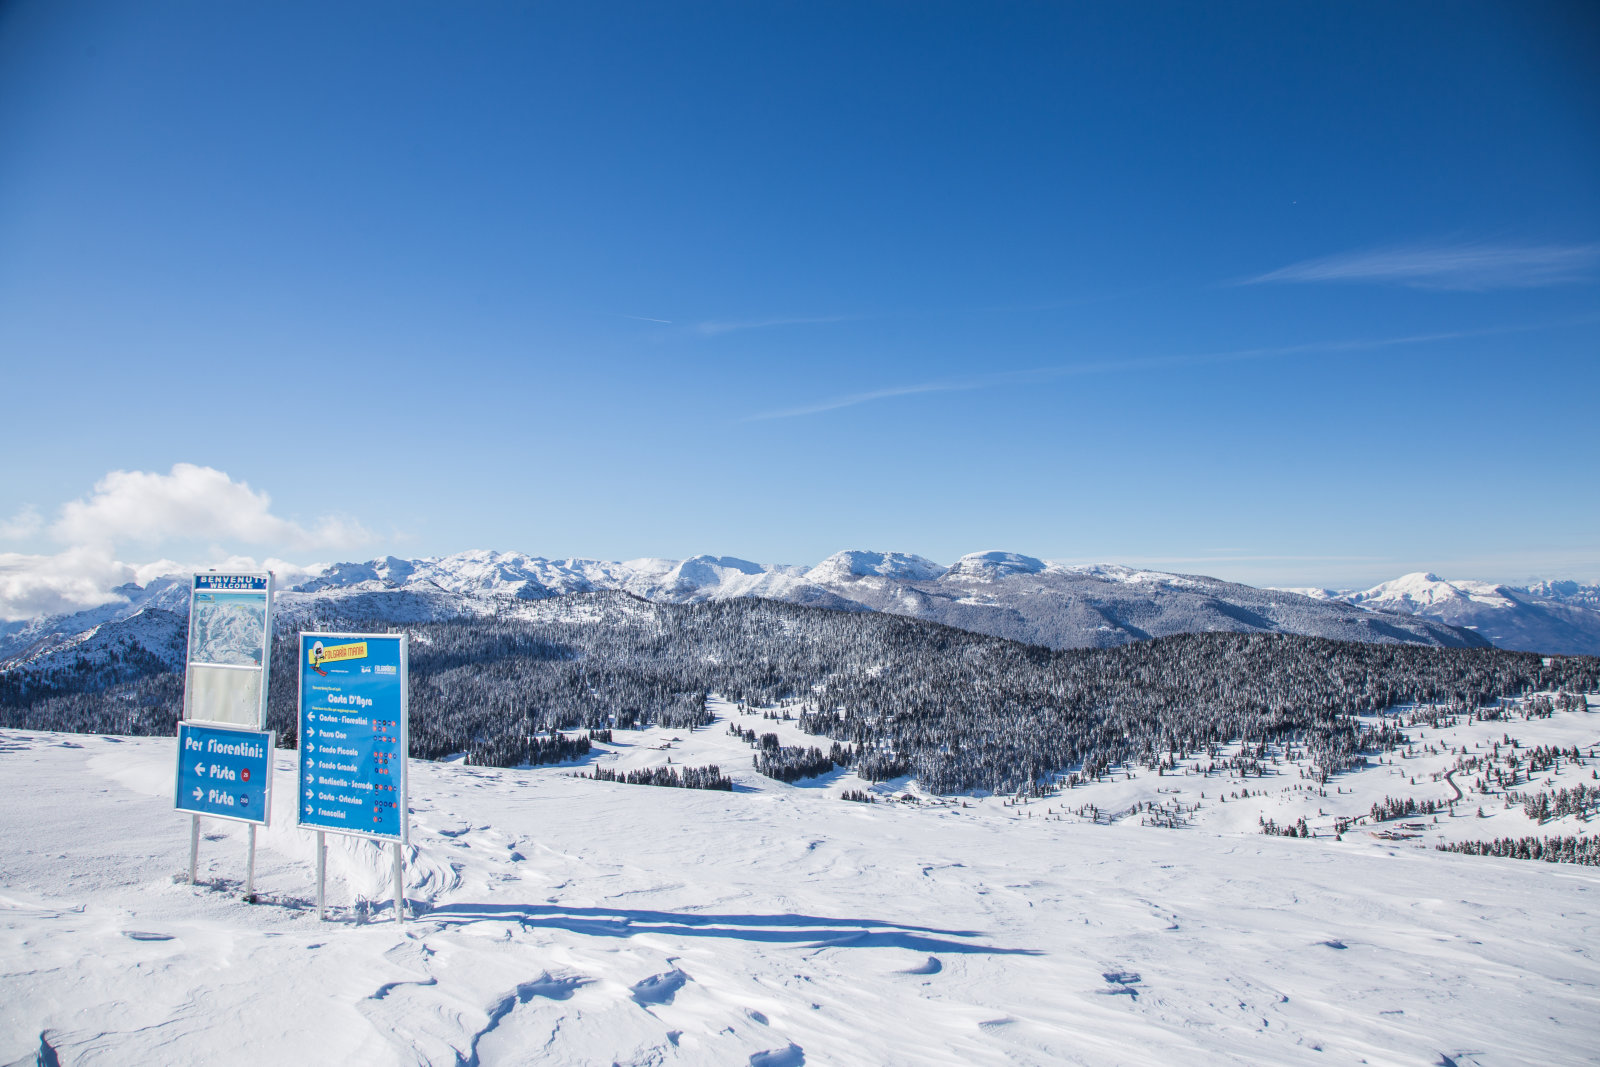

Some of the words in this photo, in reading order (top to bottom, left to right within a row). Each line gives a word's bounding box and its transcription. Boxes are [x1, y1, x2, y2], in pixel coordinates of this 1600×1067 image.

[328, 694, 347, 704] Costa
[341, 715, 367, 725] Fiorentini
[319, 729, 334, 738] Passo
[185, 737, 203, 751] Per
[207, 739, 263, 758] Fiorentini:
[319, 745, 336, 754] Fondo
[337, 746, 358, 756] Piccolo
[318, 760, 336, 770] Fondo
[337, 763, 357, 772] Grande
[210, 764, 235, 780] Pista
[318, 776, 347, 787] Martinella
[208, 789, 234, 806] Pista
